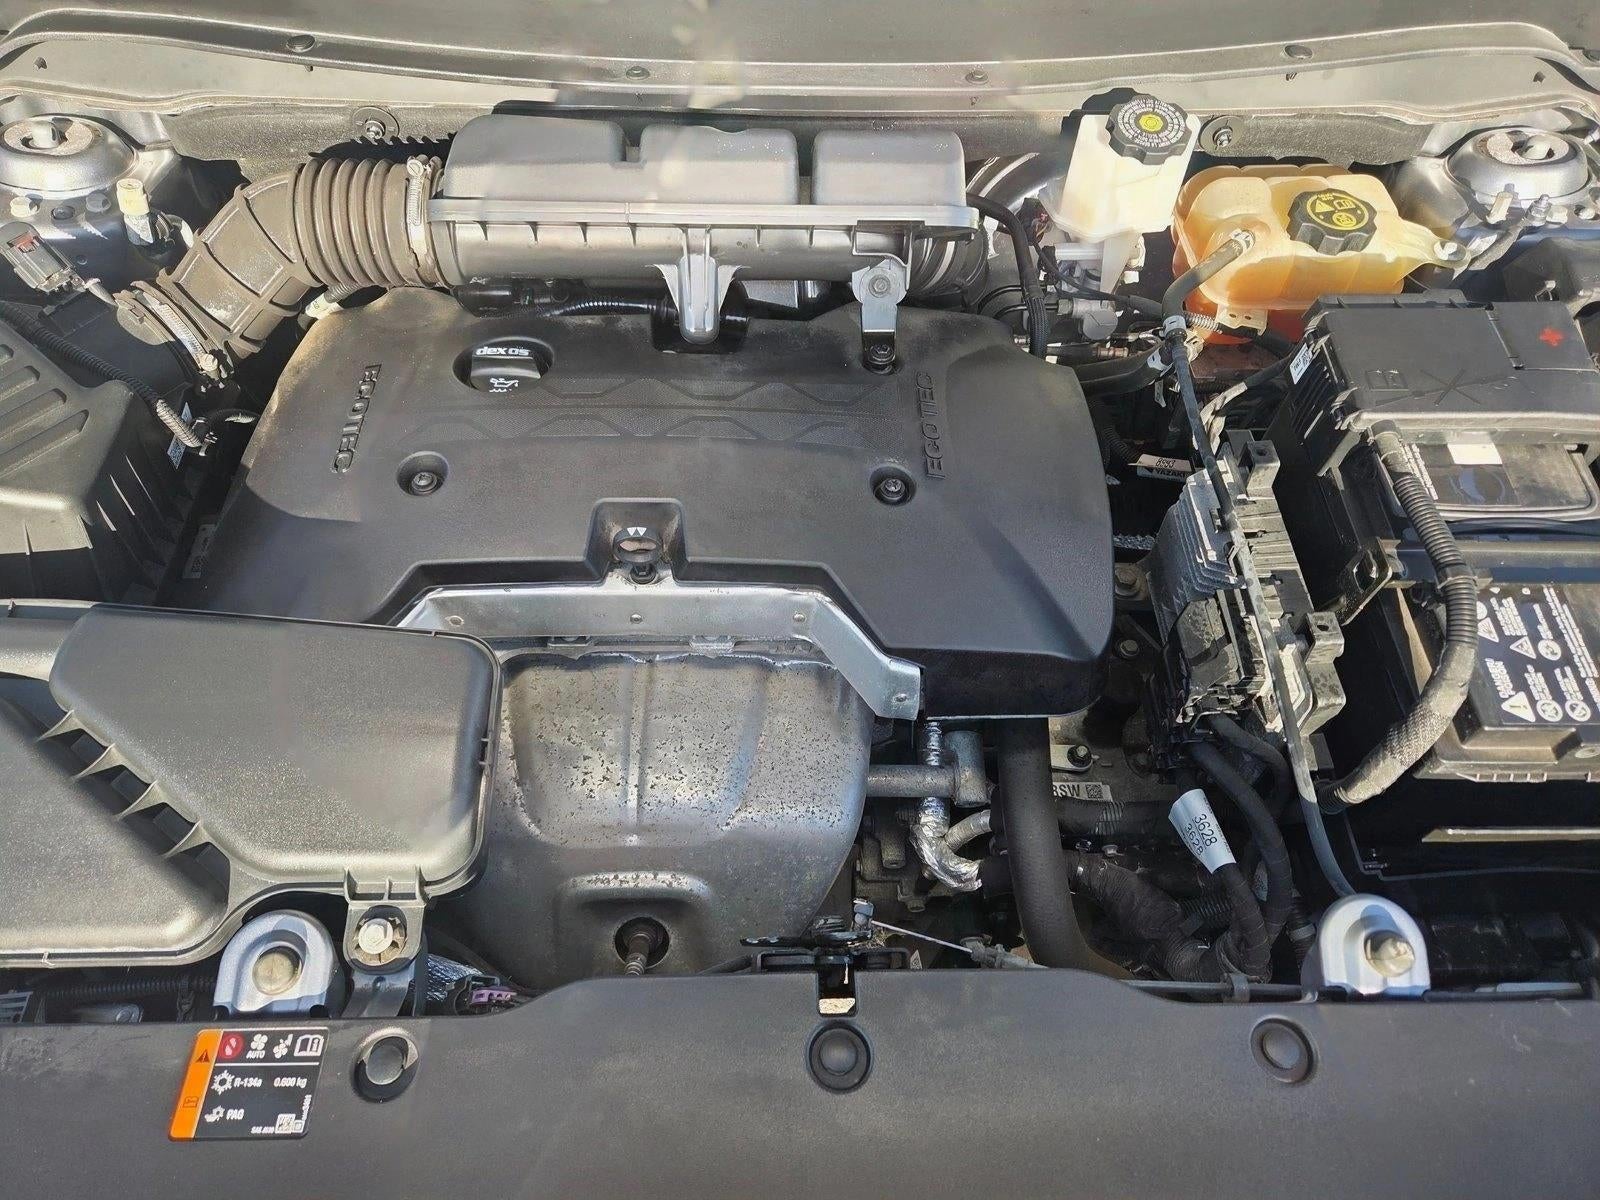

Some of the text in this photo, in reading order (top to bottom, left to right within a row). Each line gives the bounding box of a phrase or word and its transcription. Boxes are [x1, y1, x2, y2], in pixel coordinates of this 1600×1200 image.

[475, 346, 531, 356] dexos
[332, 364, 382, 474] ECOTEC
[916, 371, 945, 479] ECOTEC
[1194, 814, 1217, 847] 3628
[245, 1050, 266, 1059] AUTO
[233, 1077, 263, 1088] R-134a
[296, 1077, 307, 1089] kg
[226, 1109, 245, 1121] PAG
